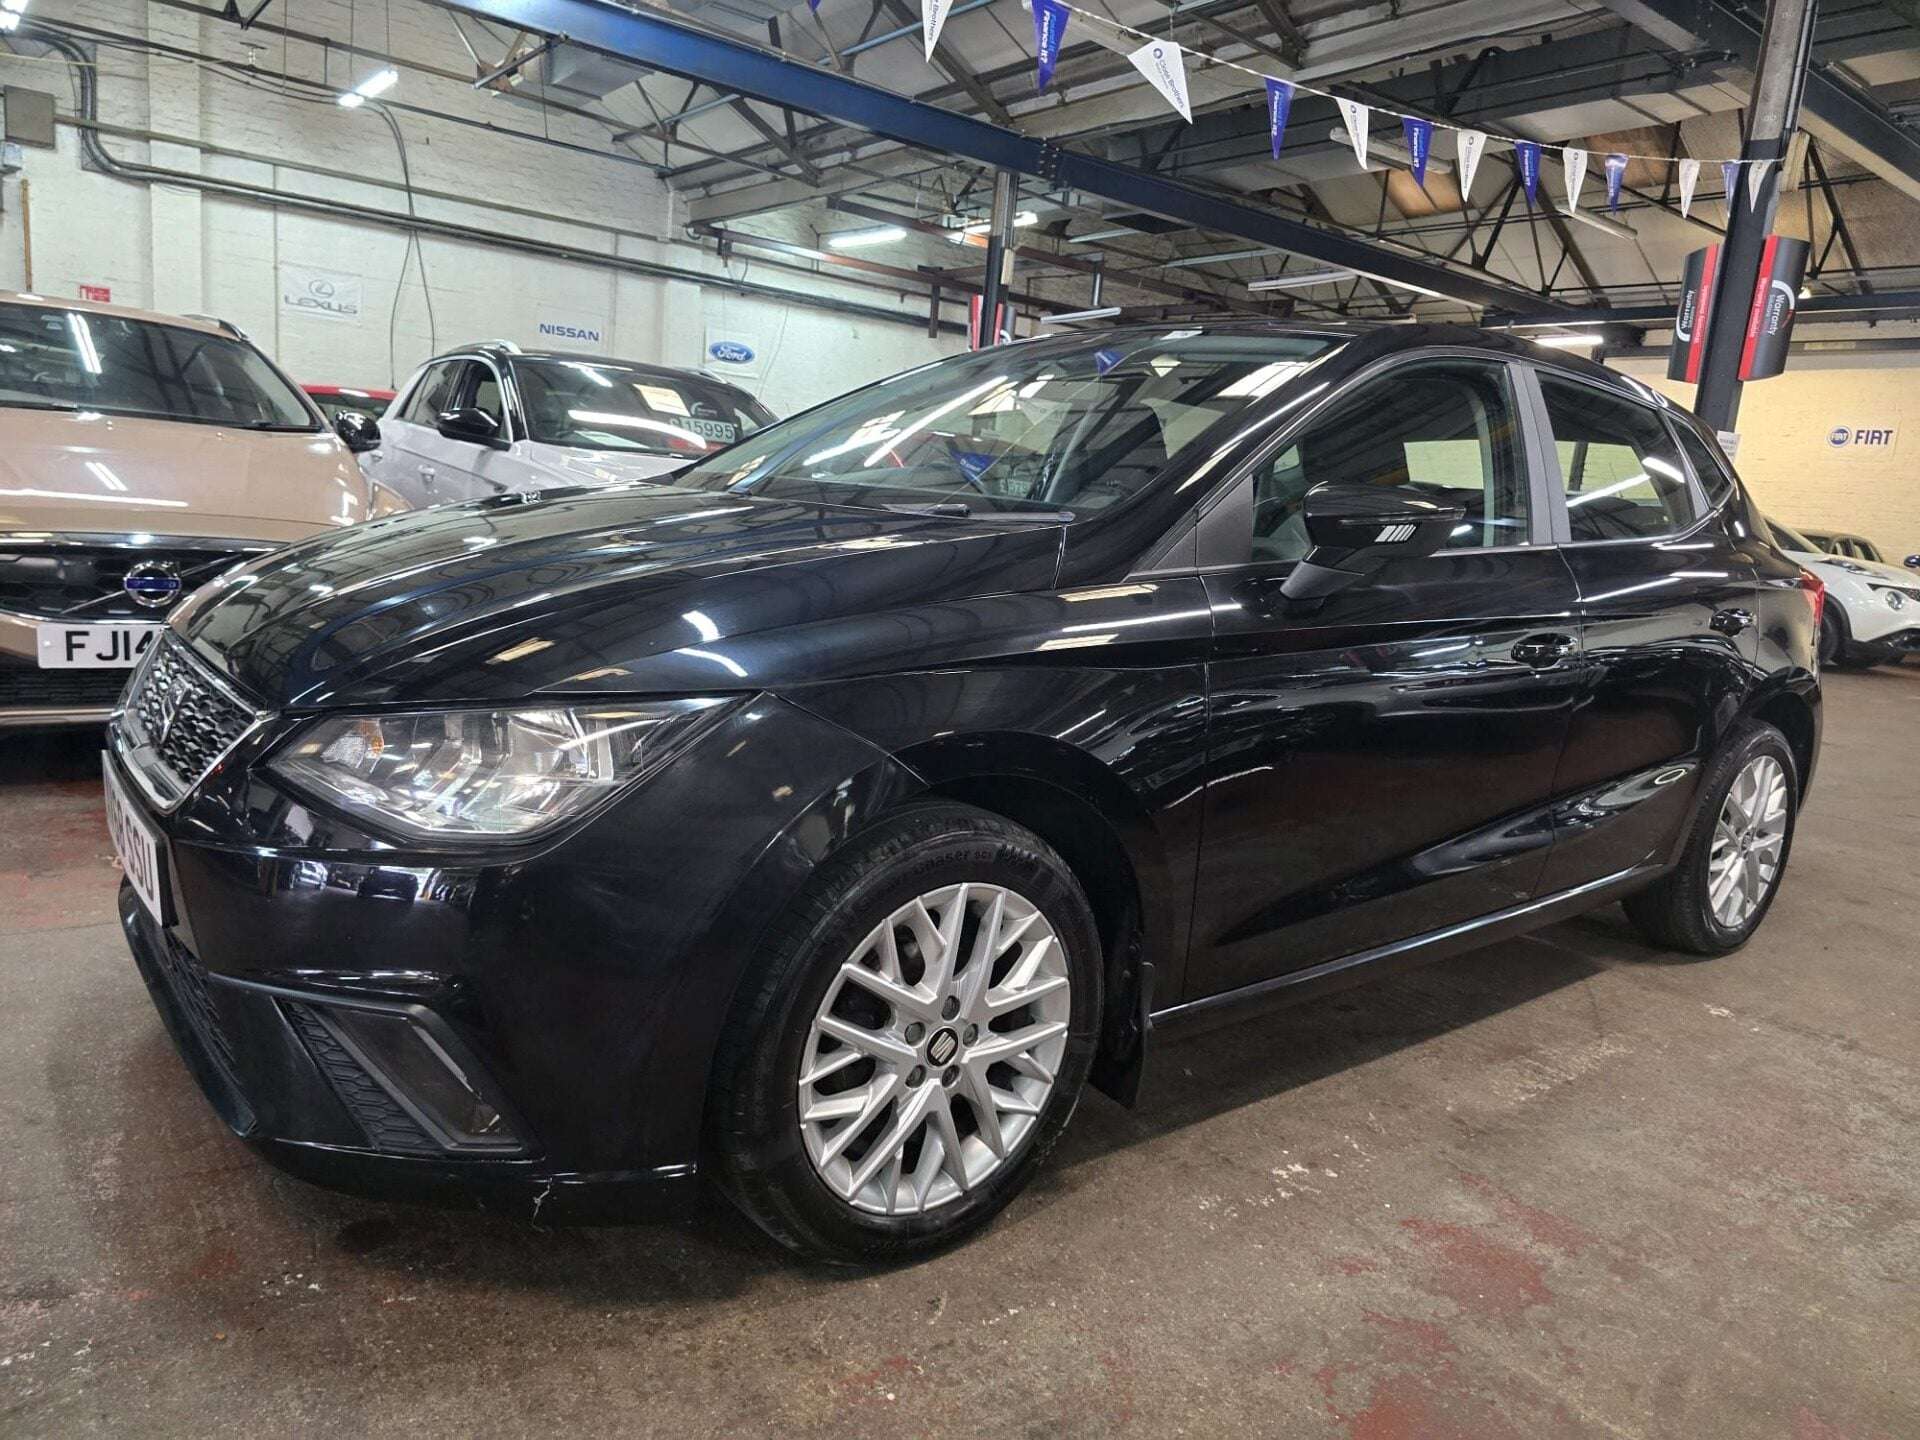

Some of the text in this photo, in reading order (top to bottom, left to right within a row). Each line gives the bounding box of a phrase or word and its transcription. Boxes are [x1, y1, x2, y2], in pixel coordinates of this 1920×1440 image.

[1042, 9, 1050, 49] Finance
[1159, 59, 1171, 80] Close
[1167, 79, 1185, 109] Brothers
[284, 295, 358, 314] LEXUS
[1680, 289, 1697, 329] Warranty
[1767, 294, 1786, 336] Warranty
[539, 323, 600, 341] NISSAN
[716, 345, 748, 361] Ford
[1854, 429, 1894, 445] FIAT
